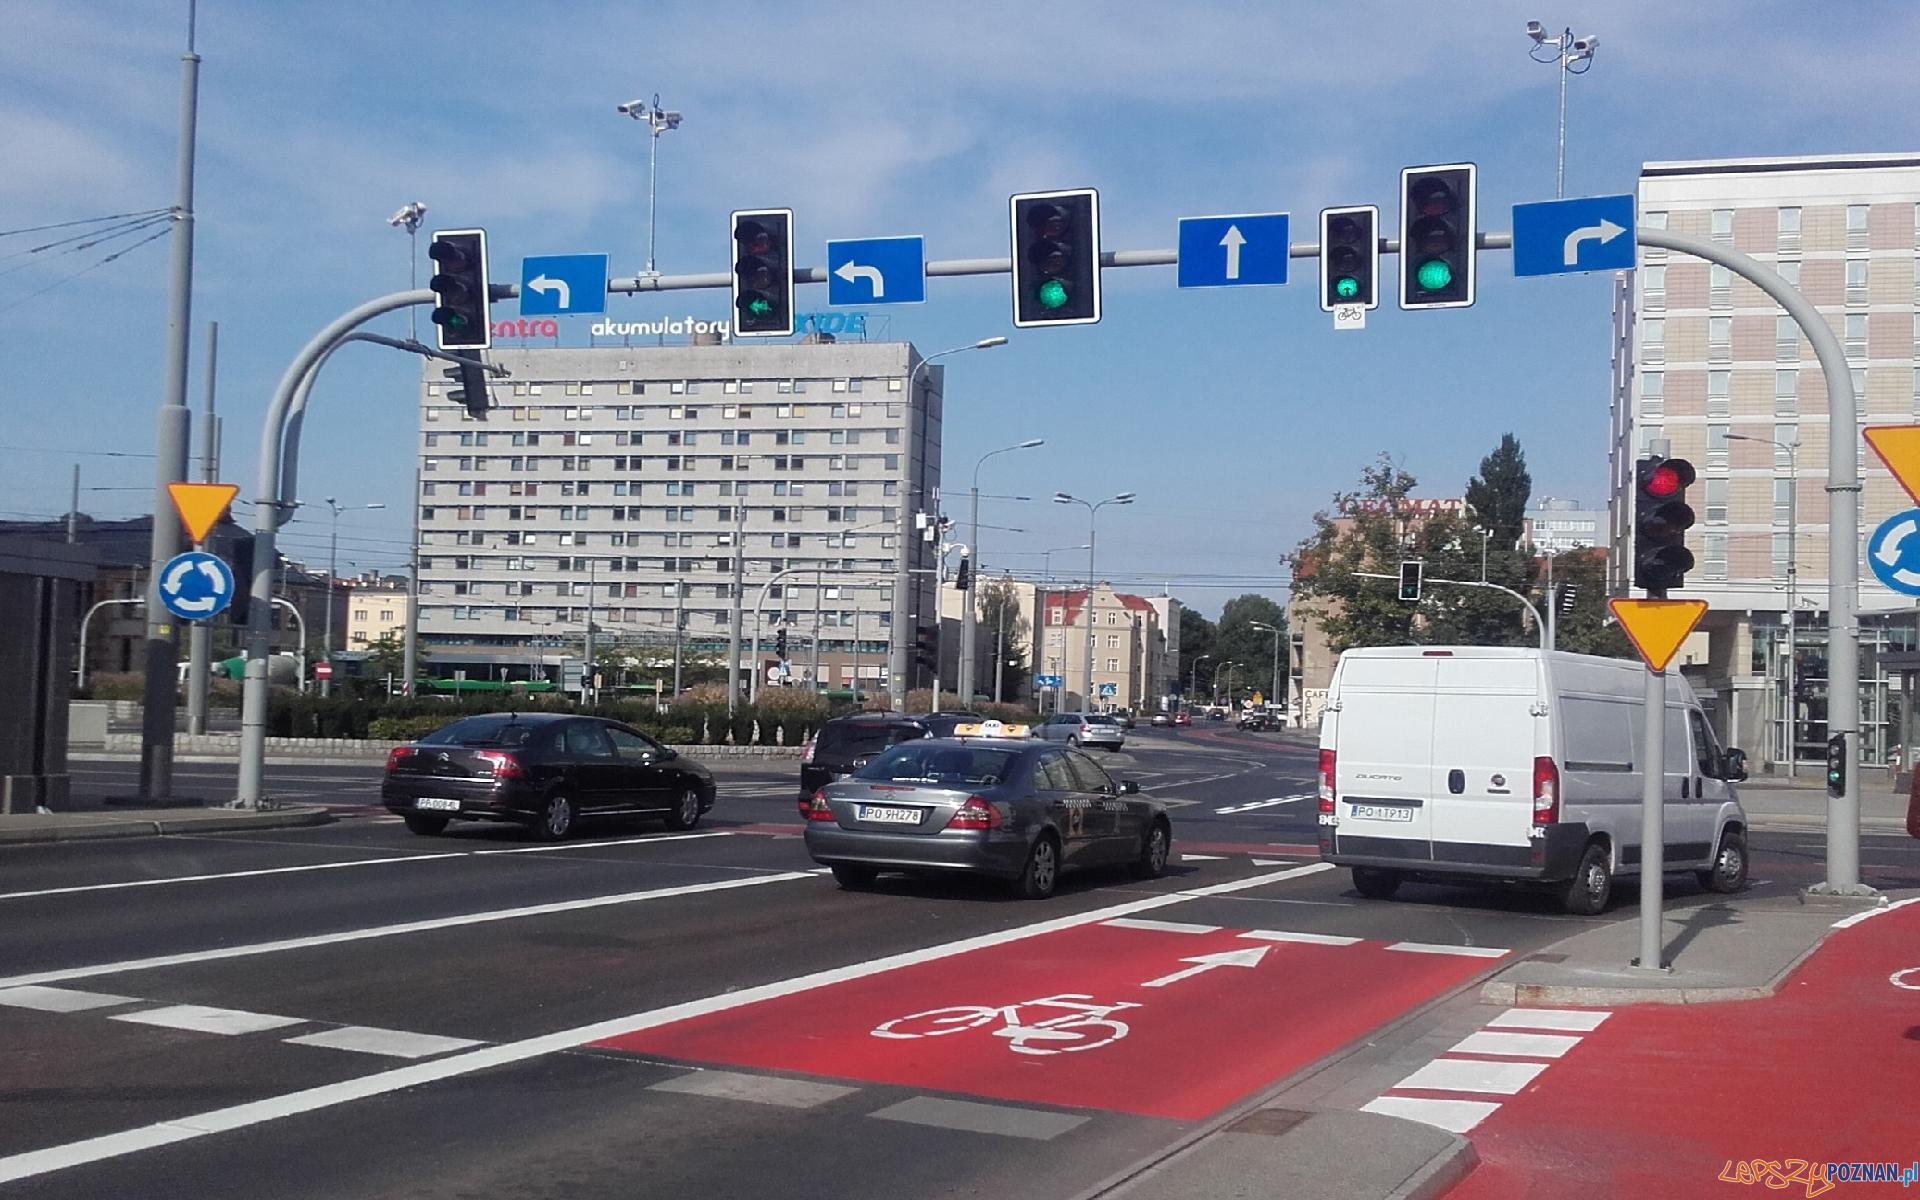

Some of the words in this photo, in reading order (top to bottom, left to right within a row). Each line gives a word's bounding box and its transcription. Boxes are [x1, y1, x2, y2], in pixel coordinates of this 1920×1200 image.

[591, 316, 731, 341] akumulatory
[886, 809, 918, 821] 9H278
[1359, 806, 1373, 817] PO
[1377, 808, 1409, 819] 1T913
